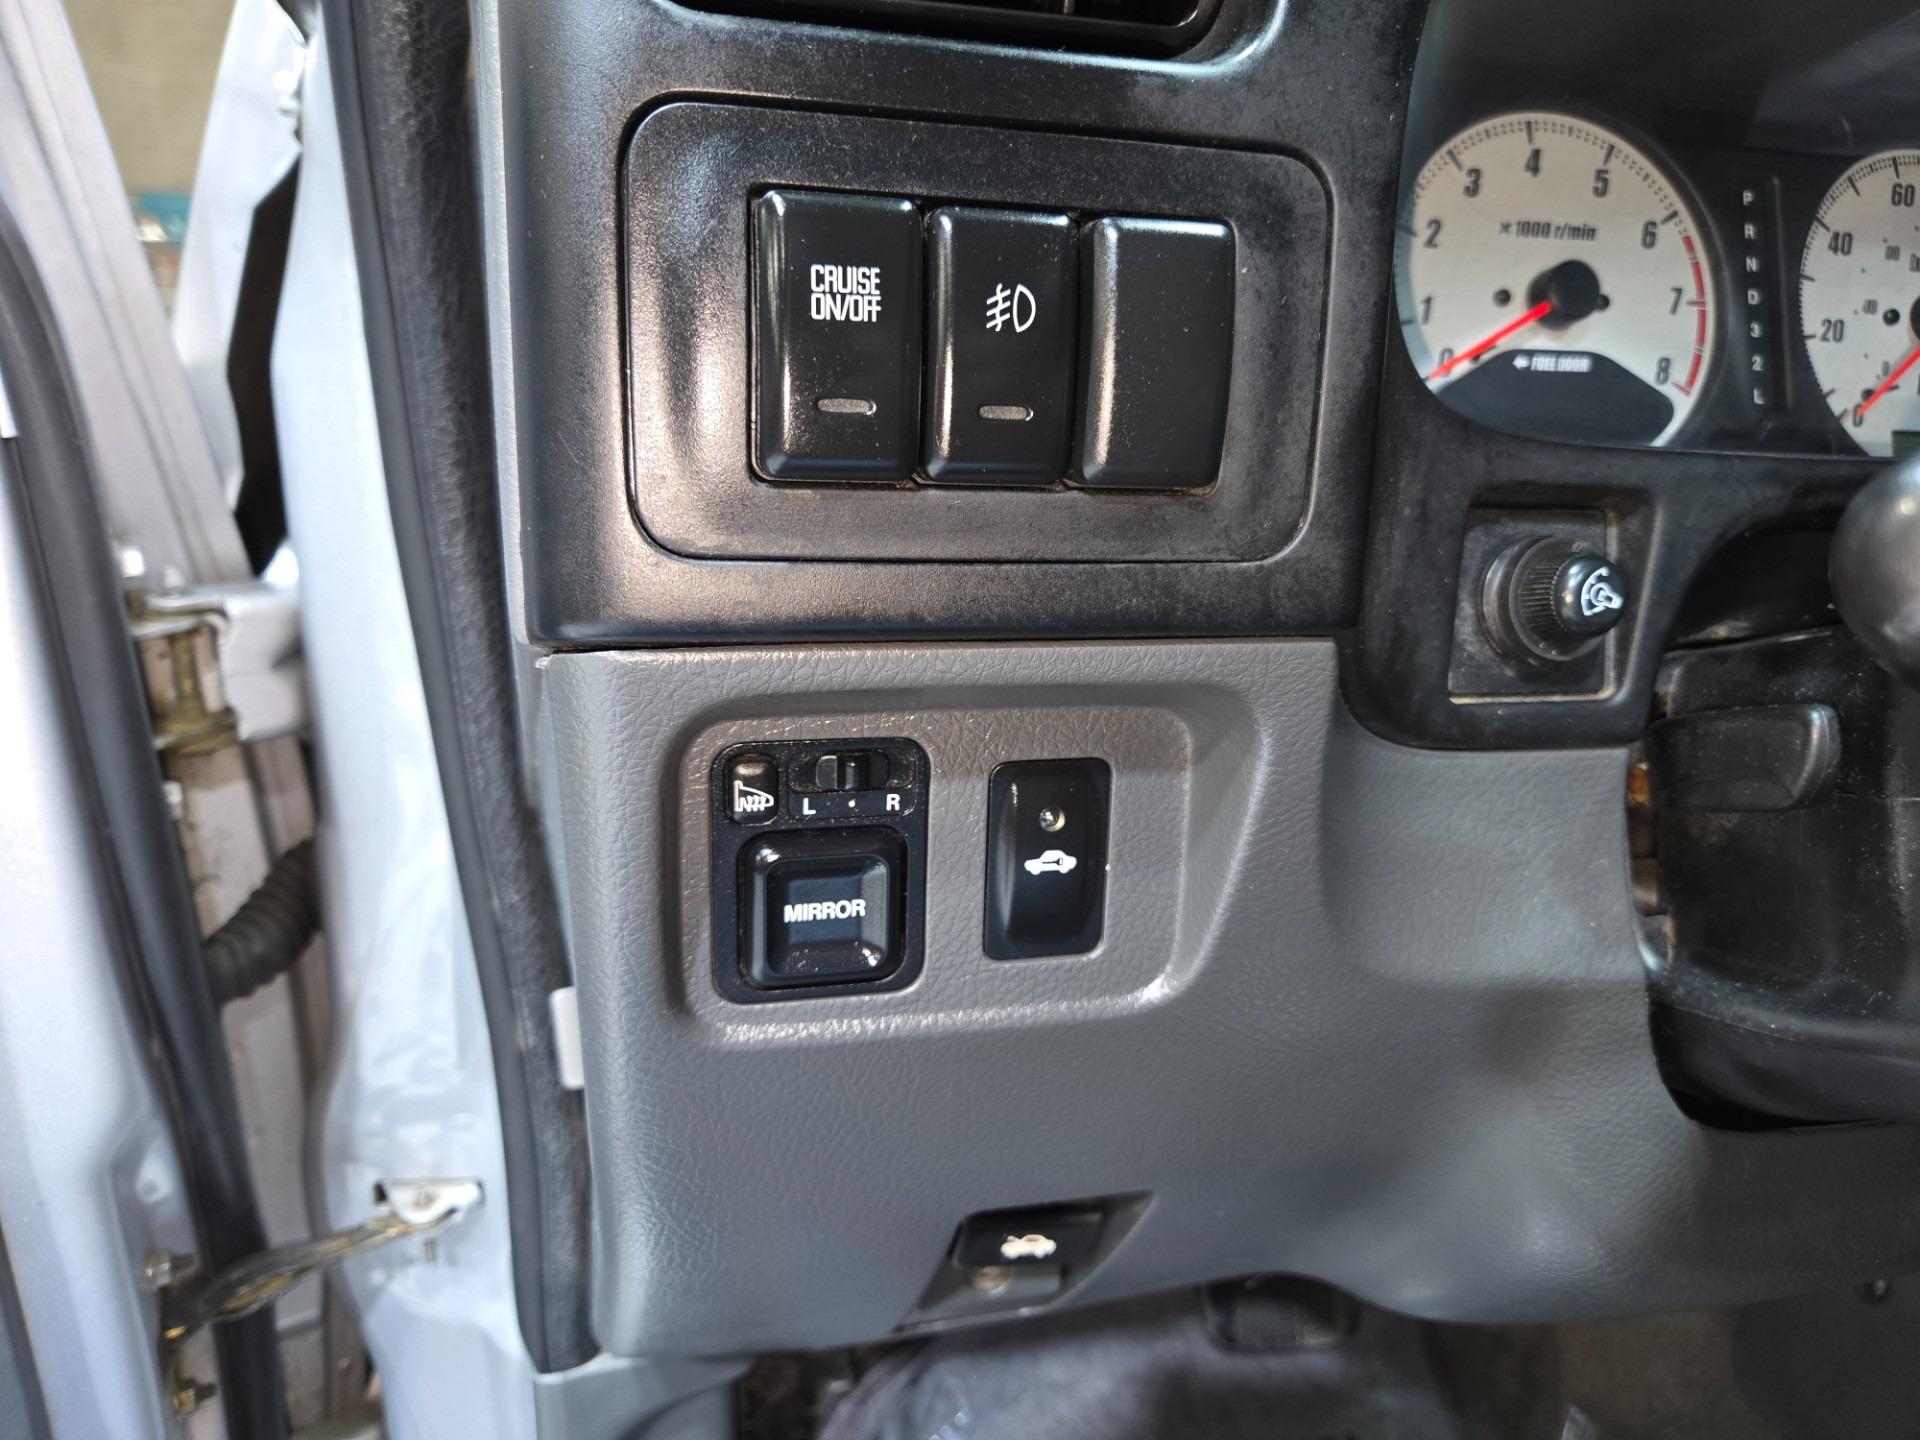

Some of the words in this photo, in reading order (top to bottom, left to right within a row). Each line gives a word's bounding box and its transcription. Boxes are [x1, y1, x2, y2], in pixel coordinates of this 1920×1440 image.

[1525, 148, 1542, 178] 4
[1463, 167, 1482, 198] 3
[1592, 169, 1609, 198] 5
[1891, 182, 1916, 207] 60
[1742, 189, 1754, 206] P
[1423, 219, 1442, 248] 2
[1553, 223, 1597, 241] r/min
[1641, 220, 1658, 249] 6
[1744, 222, 1756, 240] R
[1828, 231, 1853, 256] 40
[1745, 256, 1759, 273] N
[810, 264, 881, 294] CRUISE
[810, 294, 882, 322] ON/OFF
[1670, 287, 1683, 315] 7
[1747, 288, 1760, 305] D
[1421, 296, 1432, 325] 1
[1750, 321, 1762, 338] 3
[1820, 318, 1845, 343] 20
[1656, 357, 1671, 385] 8
[1751, 354, 1765, 372] 2
[1753, 388, 1766, 405] L
[802, 797, 816, 815] L
[886, 794, 901, 811] R
[783, 899, 866, 923] MIRROR
